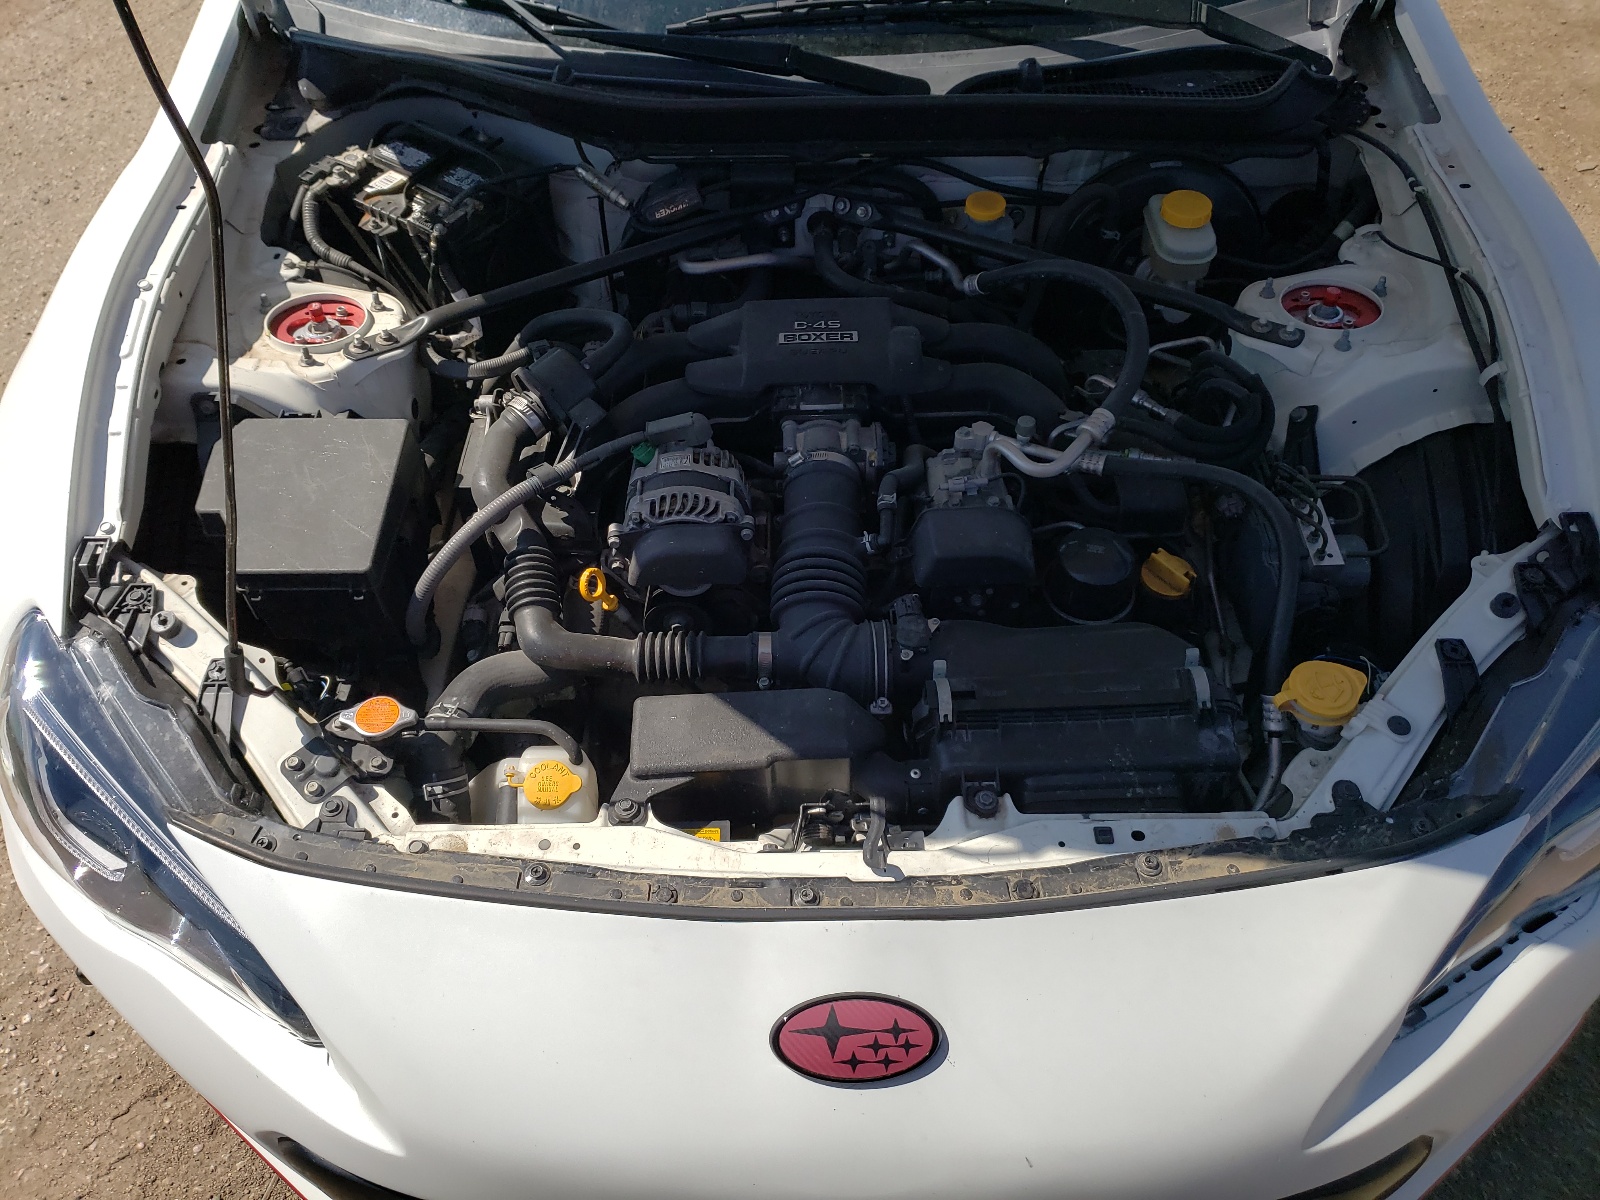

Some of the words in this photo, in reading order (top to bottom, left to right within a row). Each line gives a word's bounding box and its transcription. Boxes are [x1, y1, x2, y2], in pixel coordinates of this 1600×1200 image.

[794, 320, 841, 330] D-4S
[783, 332, 854, 342] BOXER
[529, 763, 570, 779] COOLANT
